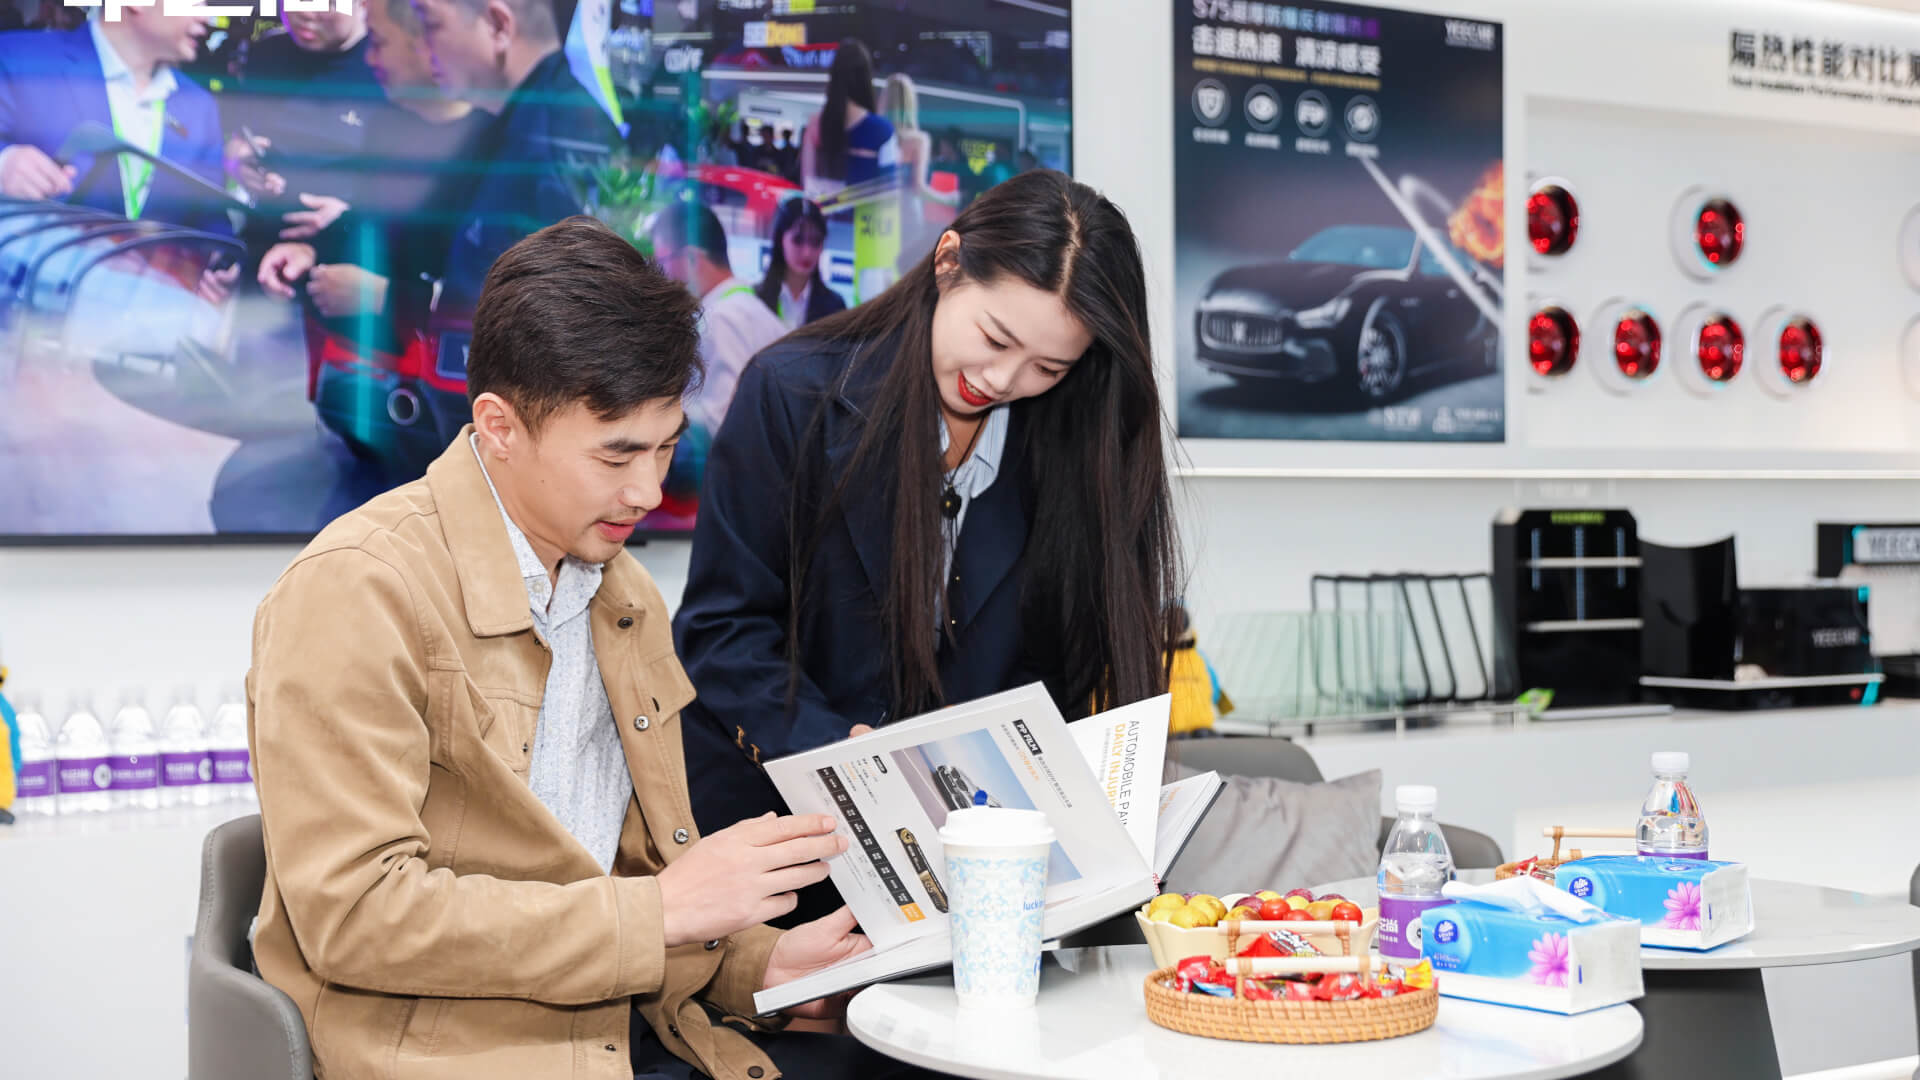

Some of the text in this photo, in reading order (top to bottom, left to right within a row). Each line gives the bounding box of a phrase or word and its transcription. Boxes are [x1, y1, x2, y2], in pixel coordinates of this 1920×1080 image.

[1023, 733, 1039, 752] FILM
[1111, 723, 1126, 757] DAILY
[1119, 720, 1140, 799] AUTOMOBILE
